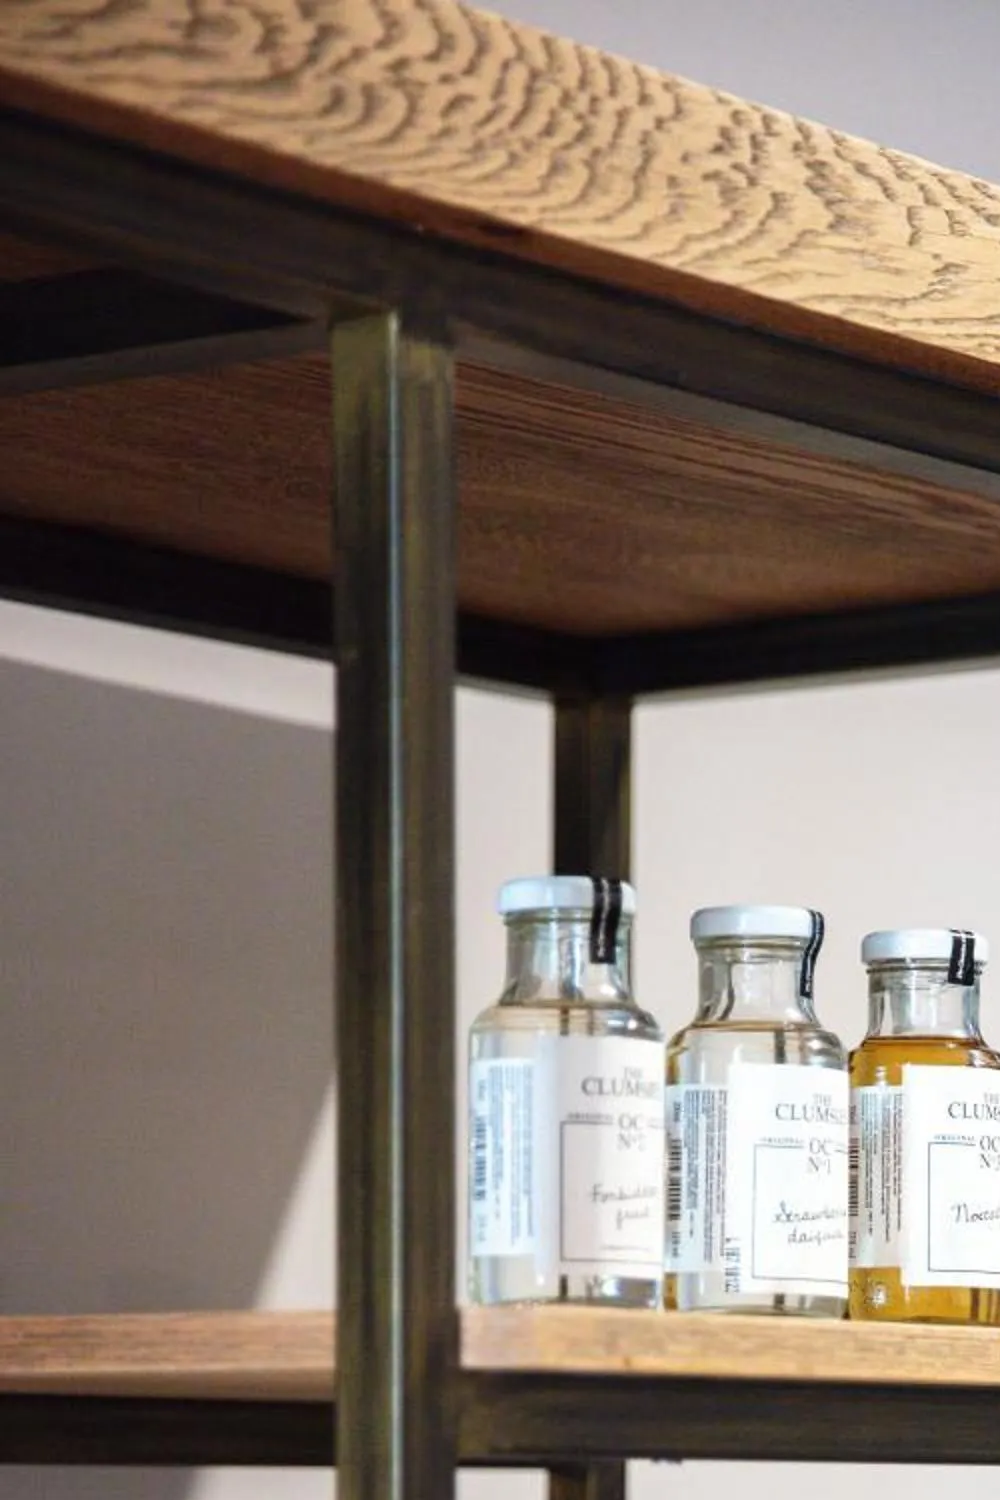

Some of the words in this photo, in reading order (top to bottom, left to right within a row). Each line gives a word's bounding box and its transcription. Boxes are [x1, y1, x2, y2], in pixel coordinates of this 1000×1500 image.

[617, 1114, 643, 1132] OC
[808, 1136, 832, 1156] OC
[978, 1135, 1000, 1153] OC
